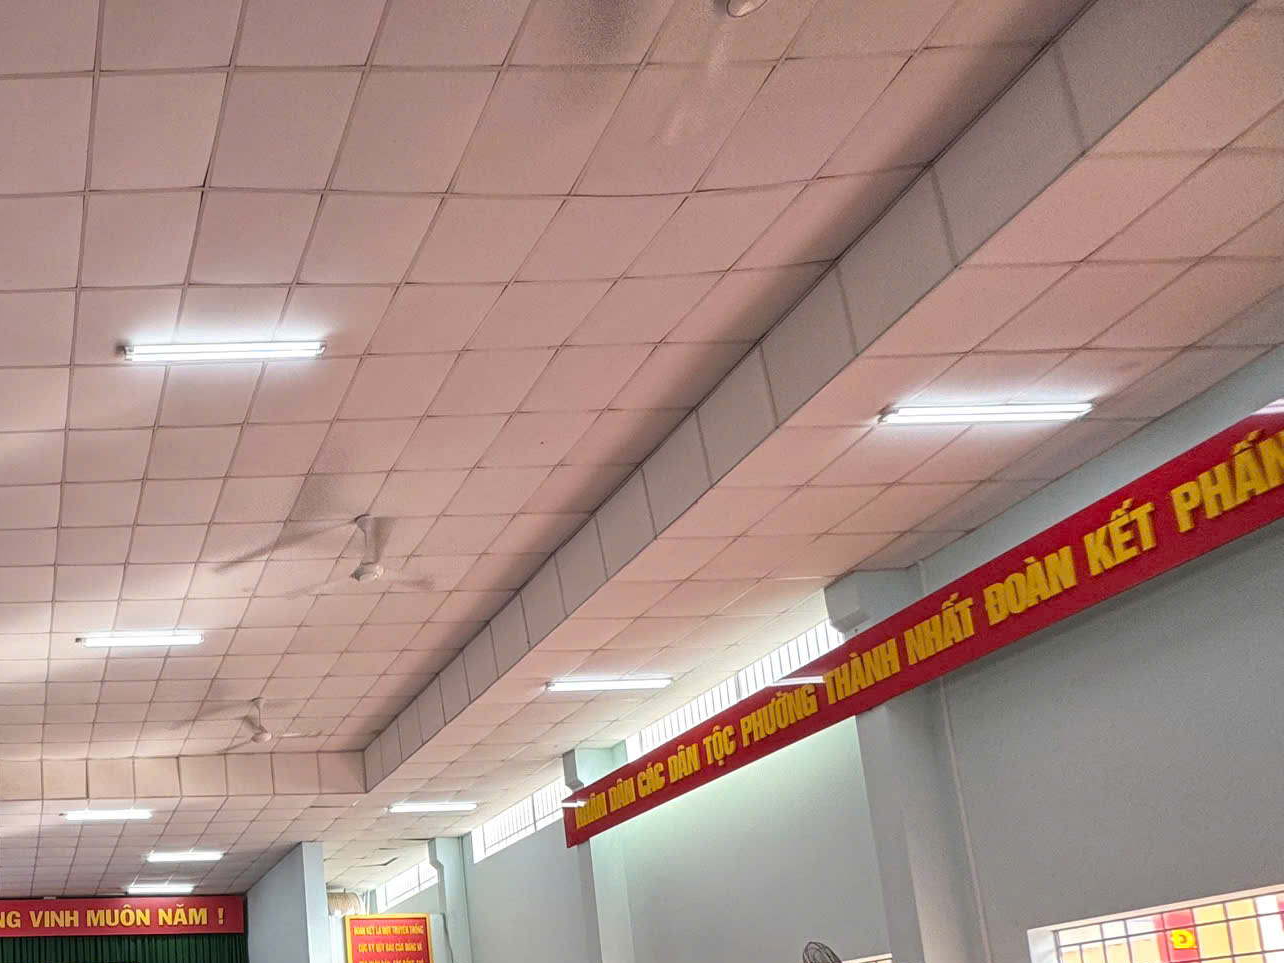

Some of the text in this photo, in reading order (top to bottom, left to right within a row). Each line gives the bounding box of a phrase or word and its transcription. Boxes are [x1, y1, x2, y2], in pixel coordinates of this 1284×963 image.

[608, 777, 636, 812] DÂN
[637, 762, 666, 798] CÁC
[667, 744, 701, 784] DÂN
[703, 725, 737, 766] TỘC
[740, 684, 819, 748] PHƯỜNG
[823, 638, 901, 705] THÀNH
[904, 592, 975, 666] NHẤT
[983, 546, 1077, 626] ĐOÀN
[1084, 498, 1157, 576] KẾT
[1170, 429, 1284, 533] PHẤN
[29, 910, 80, 928] VINH
[86, 904, 151, 927] MUÔN
[158, 904, 208, 926] NĂM
